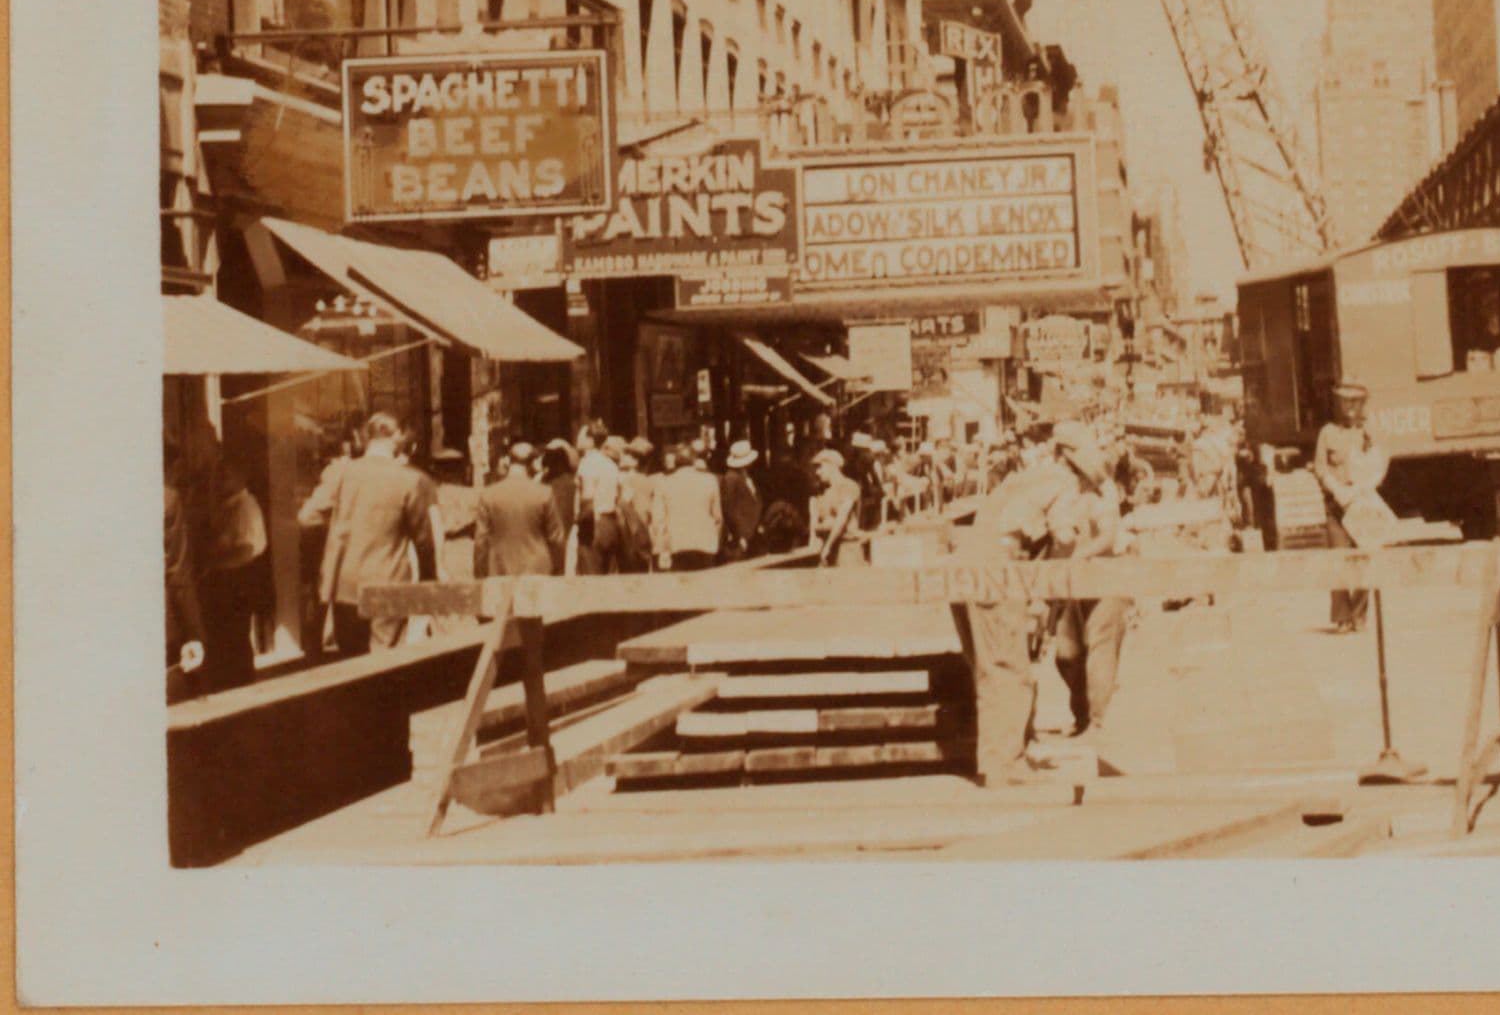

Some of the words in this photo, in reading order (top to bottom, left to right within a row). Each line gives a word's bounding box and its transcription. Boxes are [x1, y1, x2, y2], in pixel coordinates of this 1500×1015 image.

[947, 26, 998, 60] REX
[361, 66, 588, 115] SPAGHETTI
[406, 113, 547, 157] BEEF
[391, 157, 567, 203] BEANS
[846, 172, 896, 201] LON
[908, 165, 1012, 195] CHANEY
[570, 190, 787, 241] PAINTS
[803, 209, 889, 238] ADOW
[976, 201, 1060, 234] LENOX
